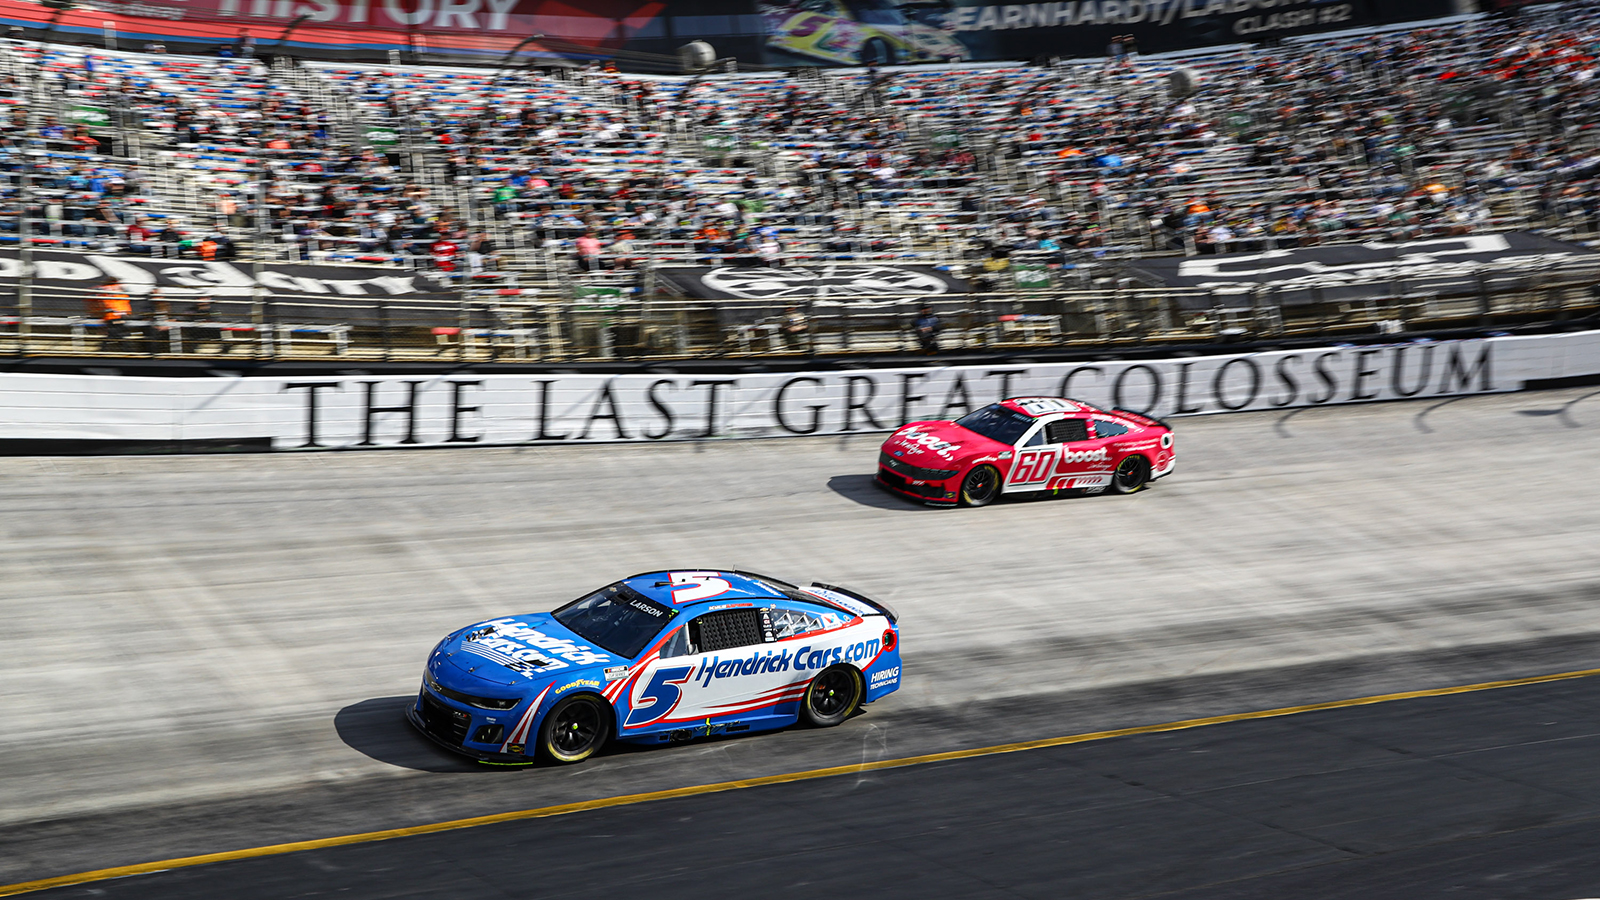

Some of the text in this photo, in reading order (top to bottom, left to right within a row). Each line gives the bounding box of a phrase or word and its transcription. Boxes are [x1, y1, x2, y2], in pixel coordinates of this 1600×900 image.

[1233, 3, 1352, 35] CLASH #2
[280, 341, 1494, 448] THE LAST GREAT COLOSSEUM
[1008, 451, 1056, 484] 60
[1064, 446, 1108, 464] boost
[667, 571, 733, 605] 5
[630, 599, 664, 618] LARSON
[475, 618, 611, 666] Hendrick
[555, 679, 600, 694] GOODYEAR
[871, 666, 900, 683] HIRING
[620, 664, 697, 728] 5
